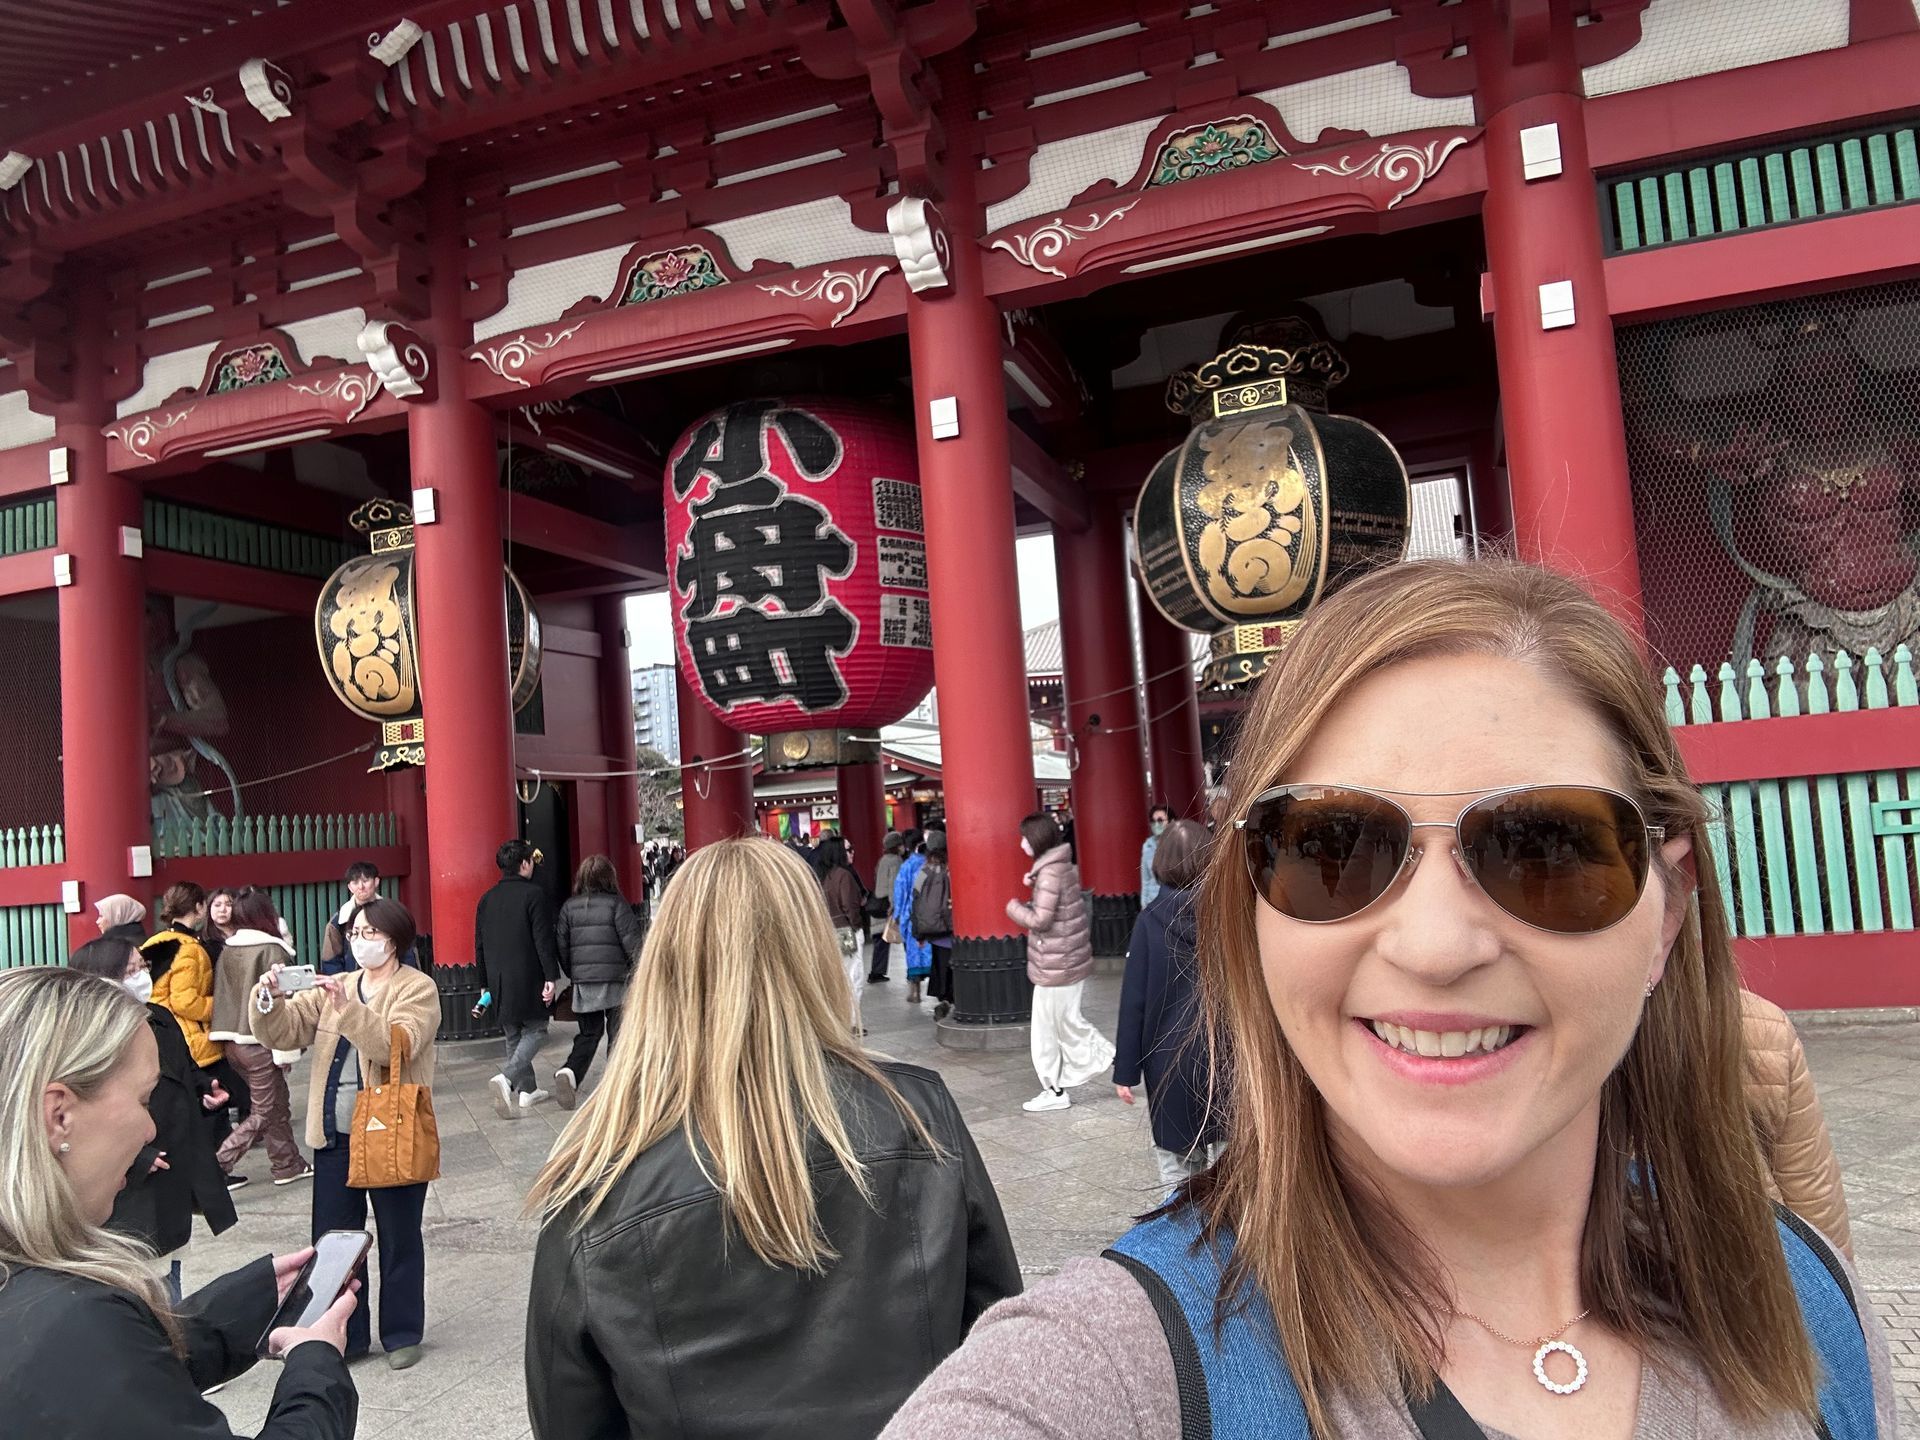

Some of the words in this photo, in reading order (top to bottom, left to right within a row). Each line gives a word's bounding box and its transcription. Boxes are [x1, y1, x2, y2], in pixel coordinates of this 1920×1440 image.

[673, 400, 859, 713] 小舟町
[815, 806, 838, 816] みく
